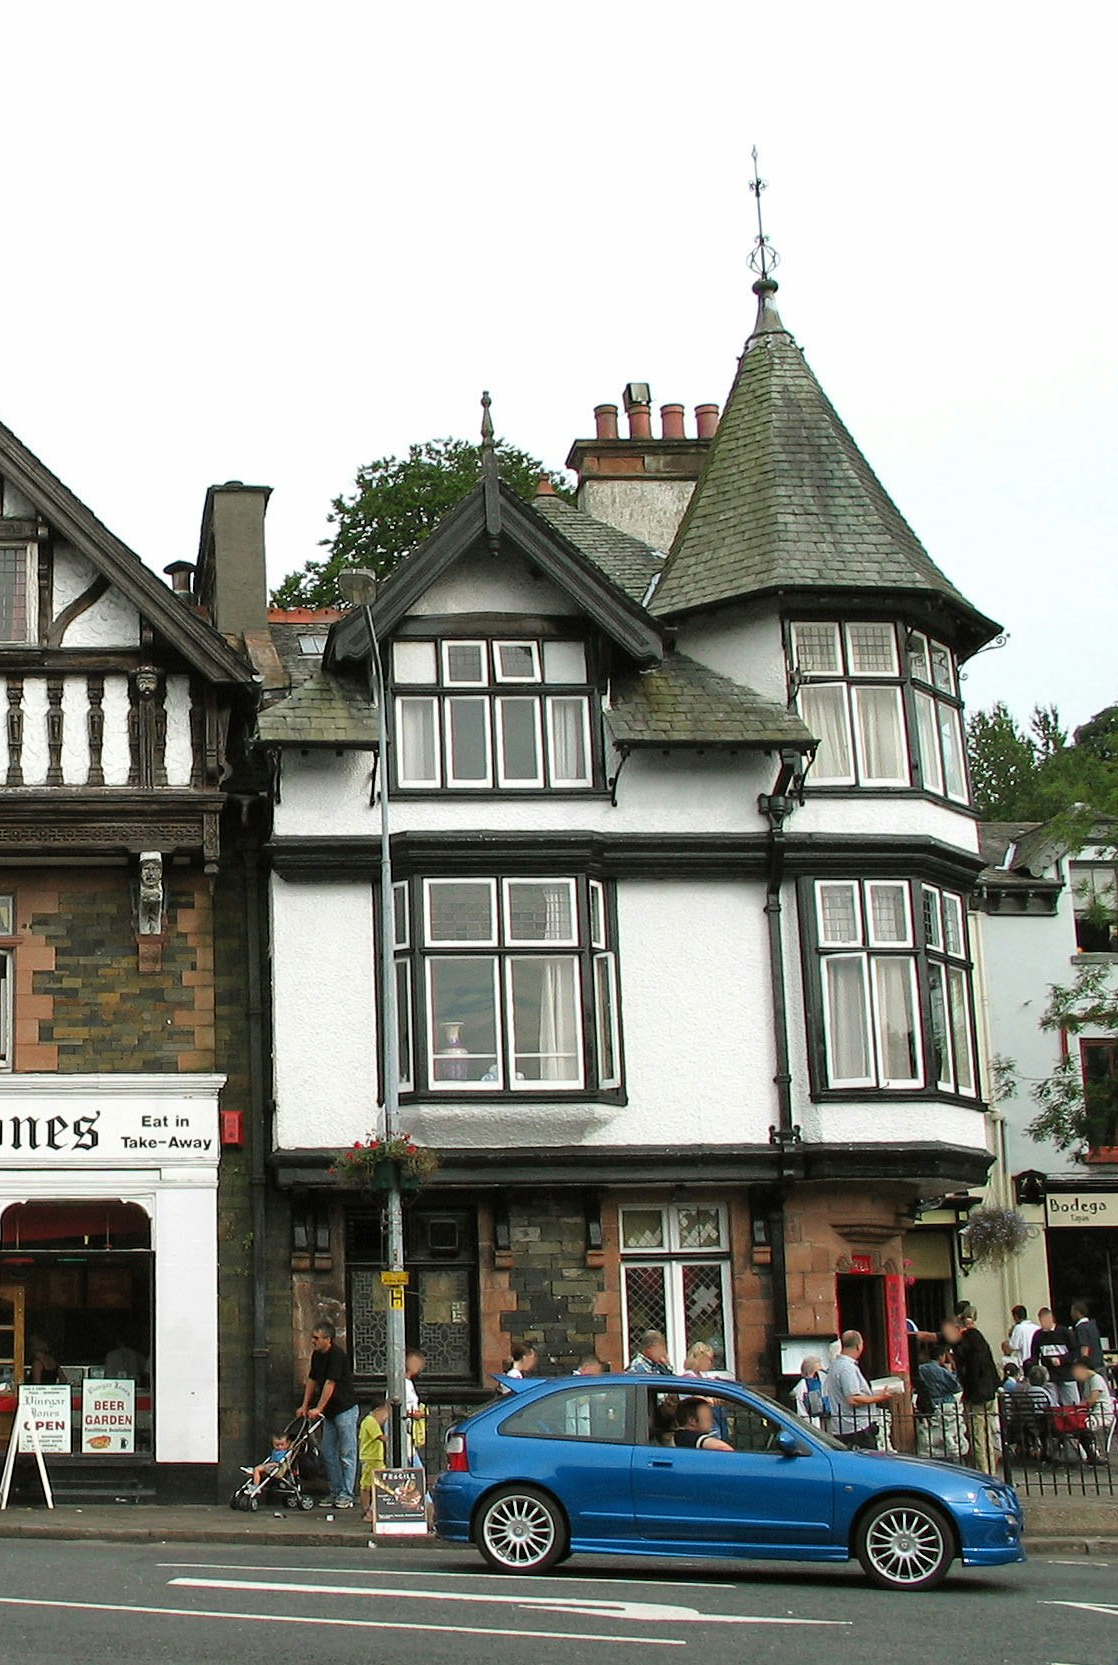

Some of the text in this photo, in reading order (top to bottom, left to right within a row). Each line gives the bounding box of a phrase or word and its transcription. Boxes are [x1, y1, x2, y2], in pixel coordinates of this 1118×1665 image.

[141, 1115, 190, 1128] Eat in
[121, 1136, 212, 1151] Take-Away
[1049, 1197, 1107, 1215] Bodega
[391, 1289, 402, 1307] H
[94, 1400, 125, 1411] BEER
[85, 1415, 133, 1425] GARDEN
